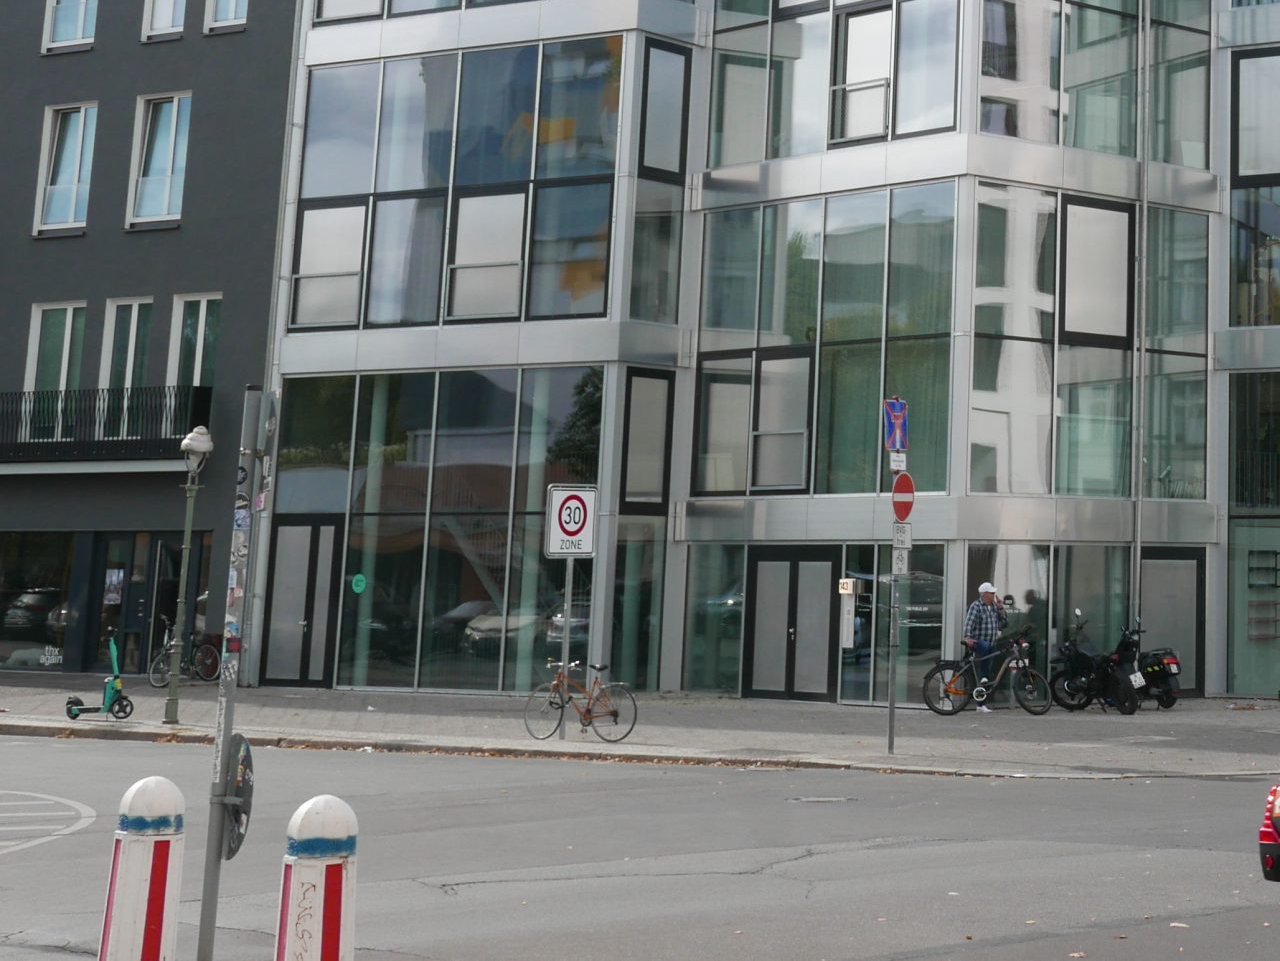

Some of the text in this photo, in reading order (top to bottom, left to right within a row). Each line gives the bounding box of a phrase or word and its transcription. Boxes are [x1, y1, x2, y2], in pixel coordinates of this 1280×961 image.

[563, 506, 582, 525] 30
[559, 539, 583, 550] ZONE
[45, 645, 60, 656] thx
[40, 655, 63, 666] again
